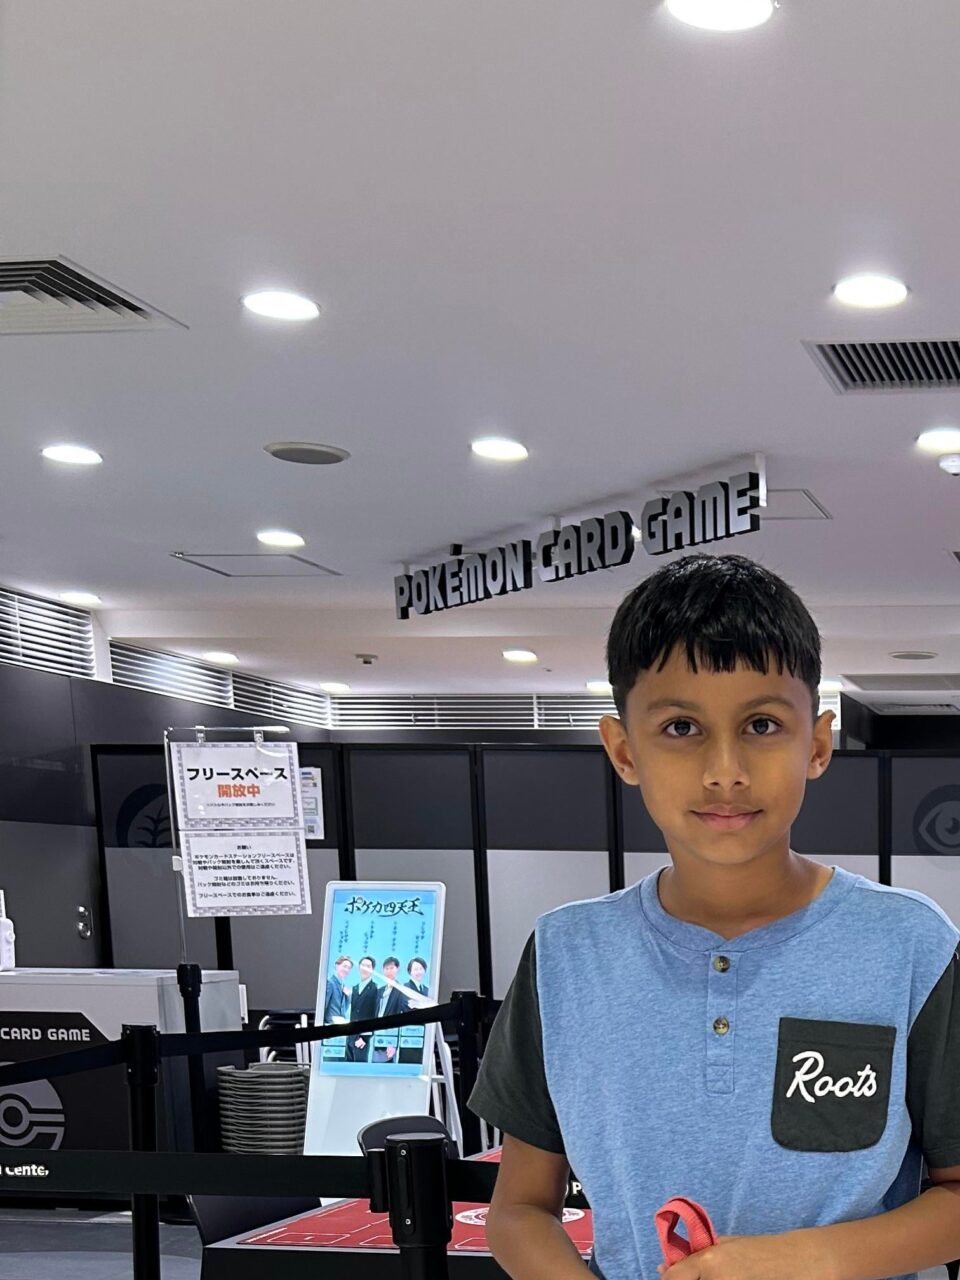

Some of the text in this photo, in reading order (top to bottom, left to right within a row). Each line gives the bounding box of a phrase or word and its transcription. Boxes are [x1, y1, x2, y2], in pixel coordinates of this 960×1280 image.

[536, 511, 634, 583] CARD
[641, 472, 759, 556] GAME
[187, 767, 287, 781] フリースペース
[217, 784, 261, 798] 開放中
[0, 1028, 91, 1041] CARD GAME
[786, 1051, 877, 1103] Roots
